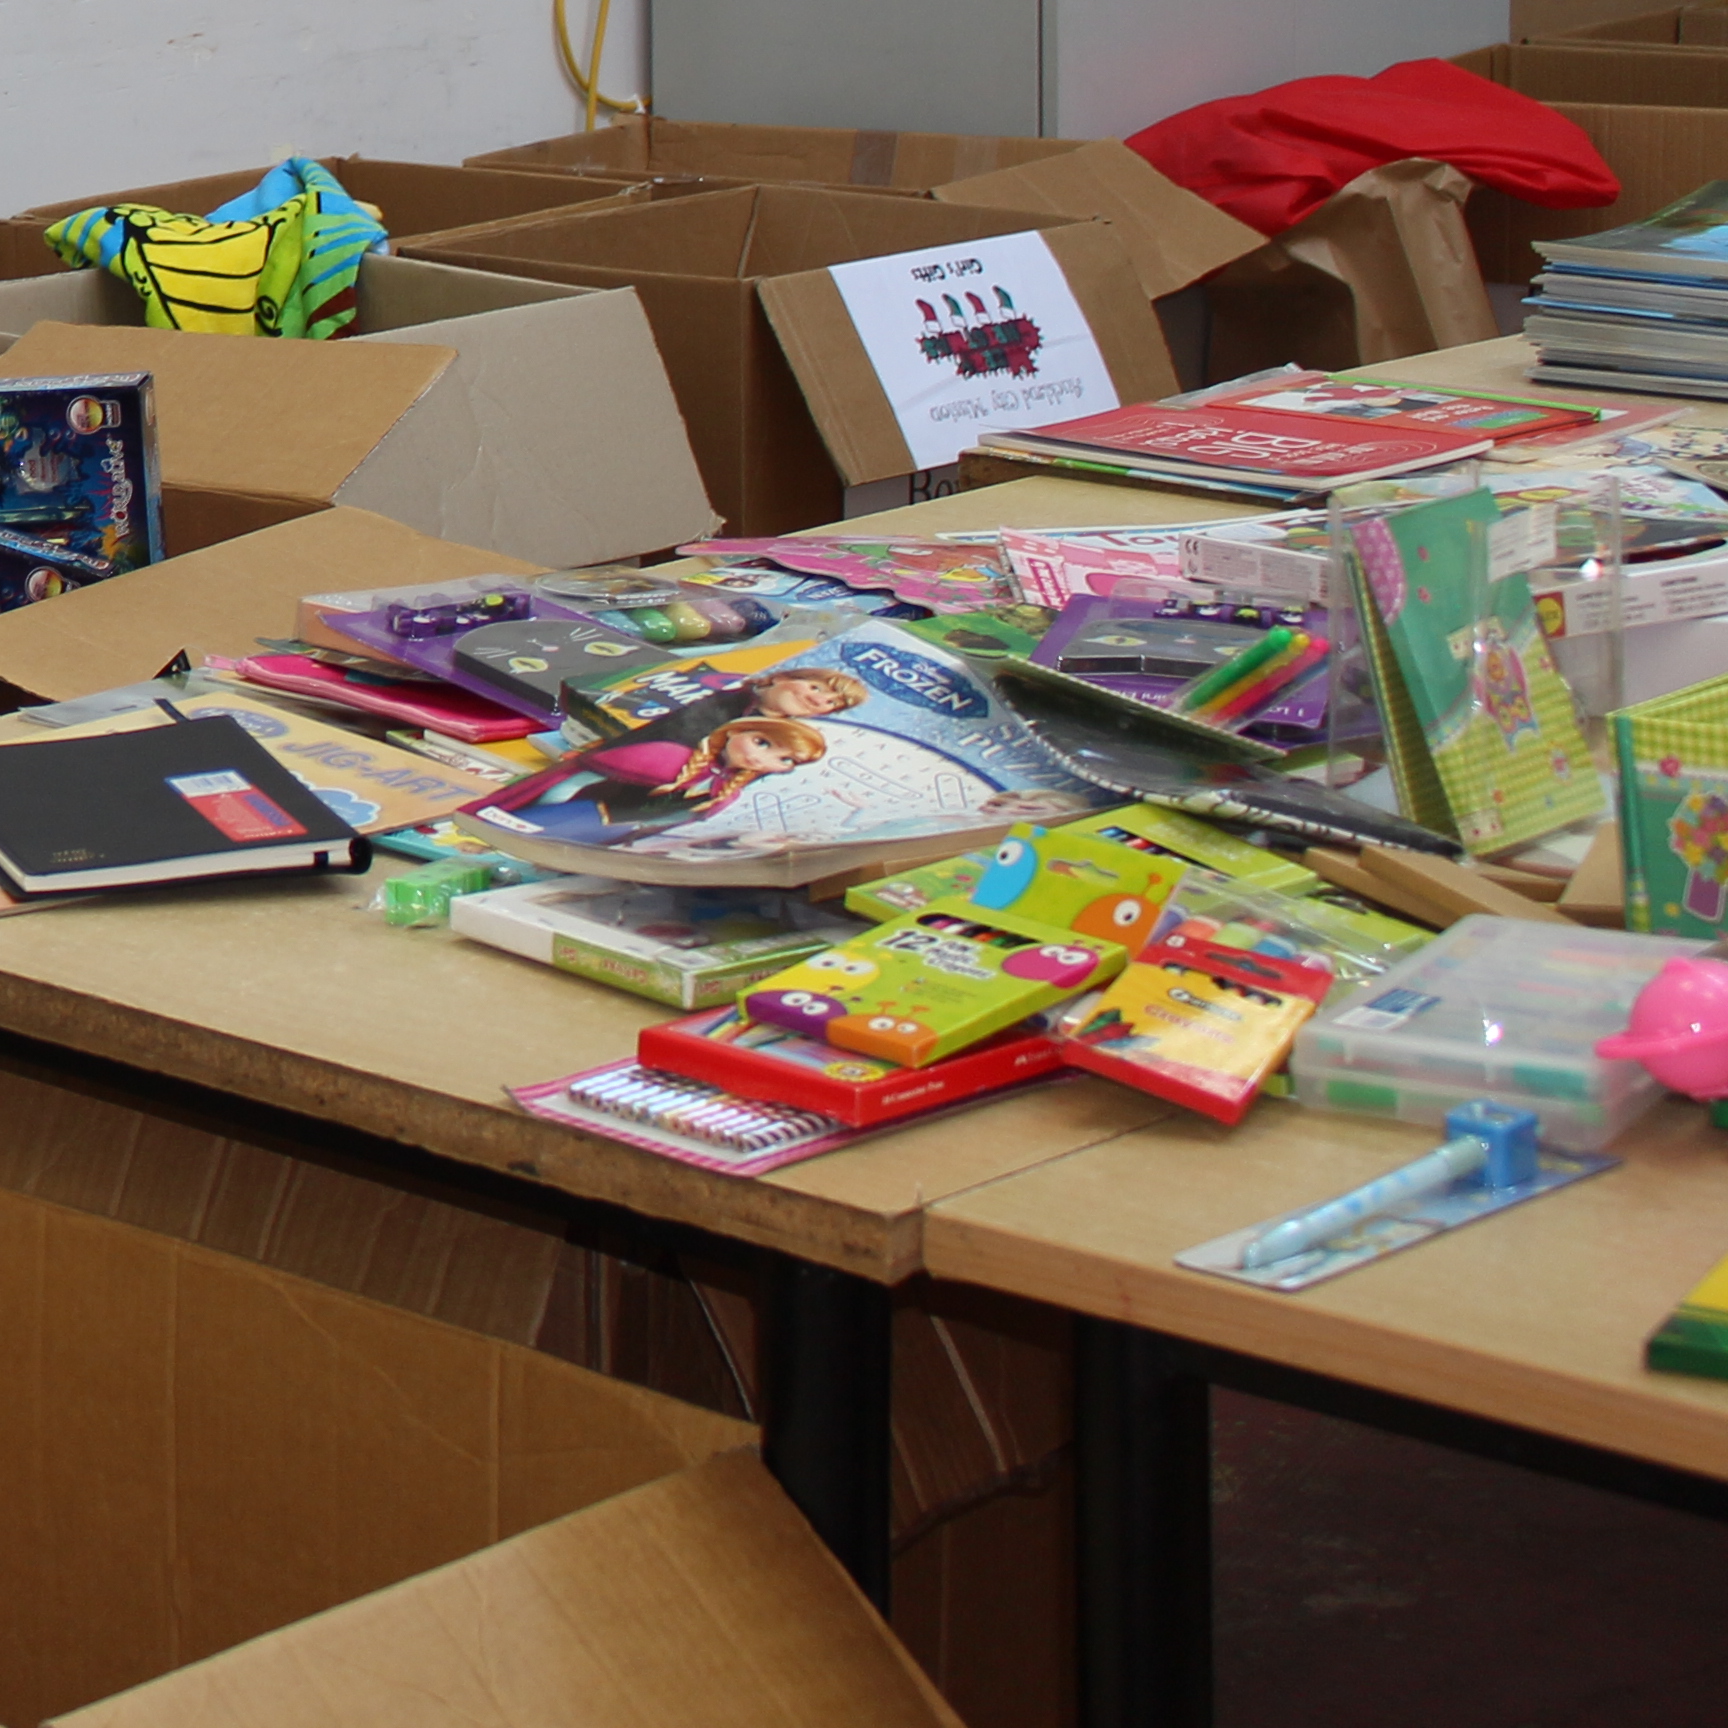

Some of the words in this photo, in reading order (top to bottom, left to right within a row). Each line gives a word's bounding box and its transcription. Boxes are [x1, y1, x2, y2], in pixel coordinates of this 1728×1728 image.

[910, 263, 945, 283] Gifts
[947, 257, 984, 279] Girl's
[991, 388, 1019, 412] City
[1022, 378, 1084, 411] Auckland
[929, 397, 989, 424] Mission
[1187, 430, 1322, 460] BIG
[855, 648, 974, 713] FROZEN
[282, 739, 481, 802] JIG-ART
[881, 928, 939, 952] 12
